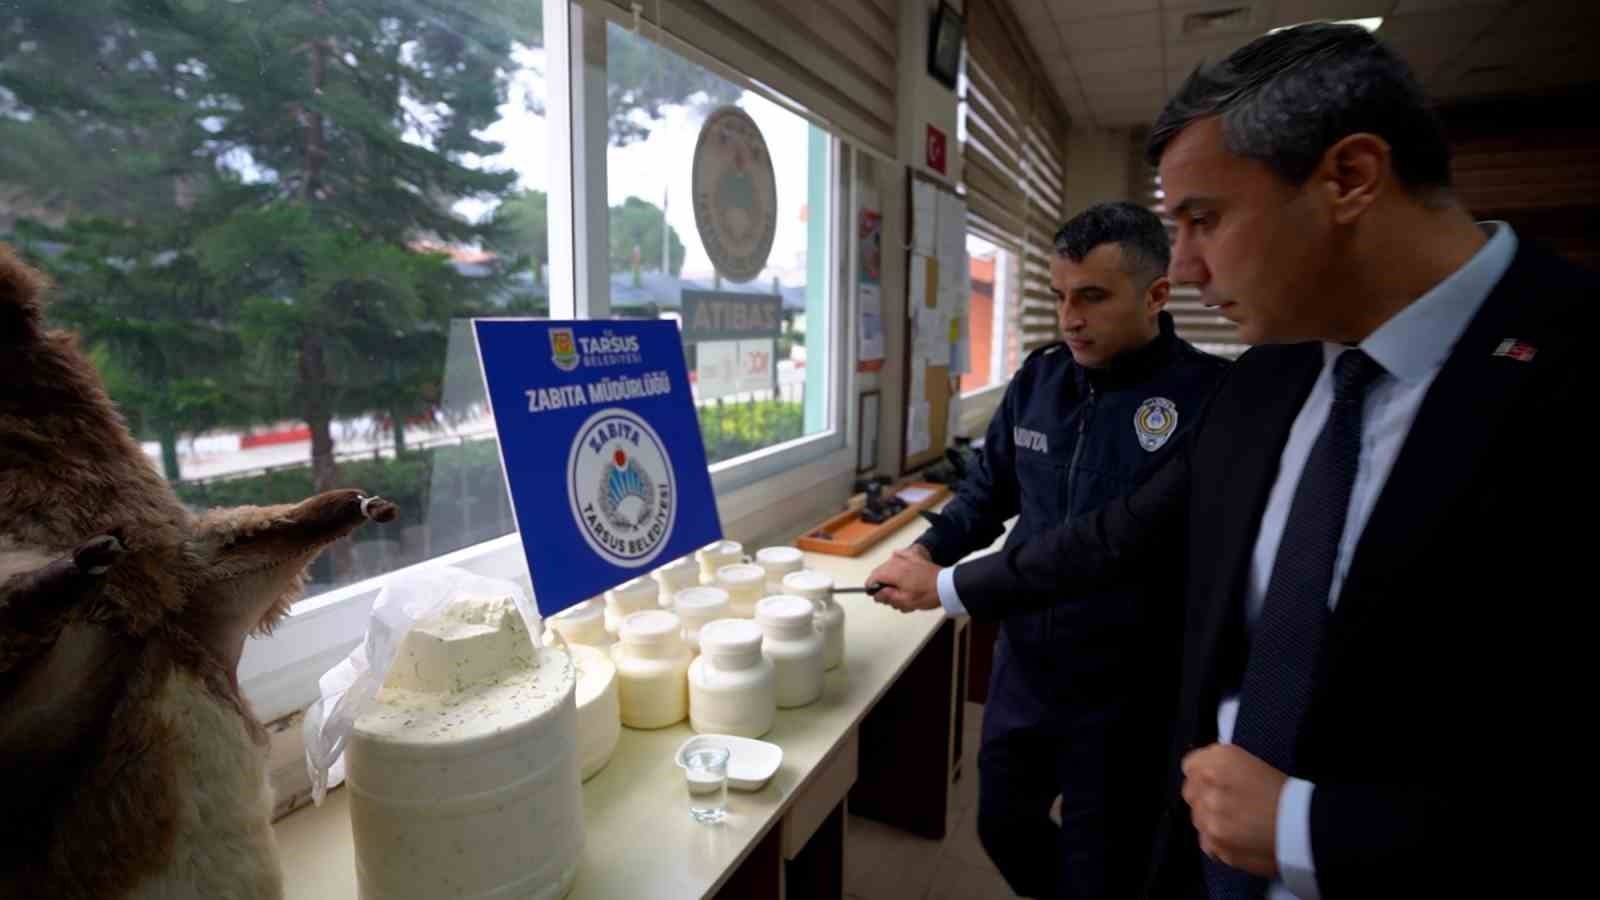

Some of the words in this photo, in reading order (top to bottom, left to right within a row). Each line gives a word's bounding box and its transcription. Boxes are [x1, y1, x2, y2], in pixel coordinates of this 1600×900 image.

[578, 336, 639, 355] TARSUS
[525, 384, 588, 413] ZABITA
[587, 370, 671, 404] MÜDÜRLÜĞÜ
[589, 423, 640, 454] ZABITA
[584, 502, 625, 553] TARSUS
